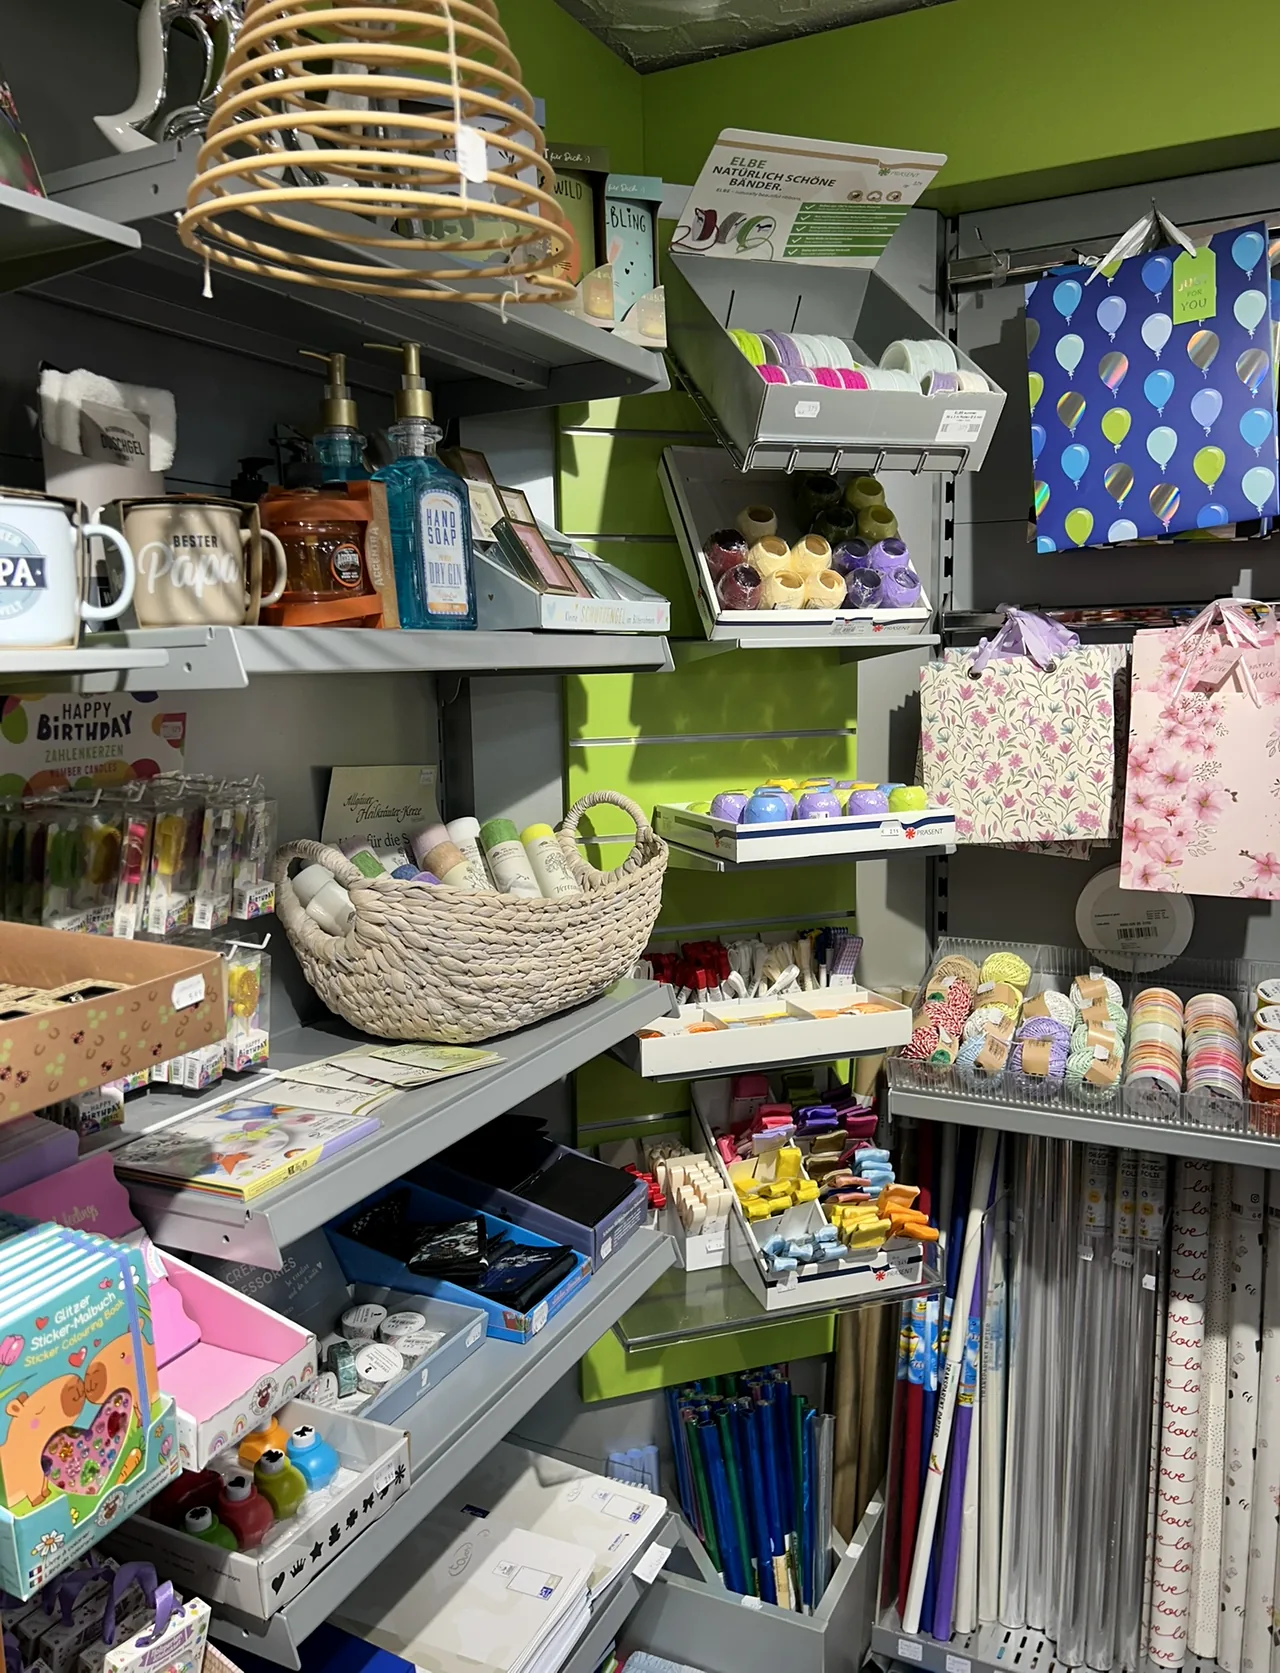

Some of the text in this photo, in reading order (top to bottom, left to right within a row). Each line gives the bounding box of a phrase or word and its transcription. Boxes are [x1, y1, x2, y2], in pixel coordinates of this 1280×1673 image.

[730, 156, 767, 169] ELBE
[712, 166, 837, 187] NATÜRLICH SCHÖNE
[729, 178, 782, 191] BÄNDER.
[553, 180, 583, 200] WILD
[1187, 289, 1203, 297] FOR
[1181, 298, 1207, 311] YOU
[101, 433, 146, 456] DUSCHGEL
[427, 508, 455, 528] HAND
[173, 535, 218, 548] BESTER
[428, 527, 456, 546] SOAP
[370, 527, 385, 587] ACCENTRA
[0, 558, 37, 587] PA
[138, 541, 239, 598] Papa
[429, 562, 462, 585] DRY GIN
[62, 702, 112, 721] HAPPY
[45, 744, 124, 763] ZAHLENKERZEN
[84, 763, 117, 776] CANDLES
[367, 833, 382, 849] für
[384, 832, 401, 848] die
[226, 1264, 257, 1285] CREA
[54, 1294, 91, 1325] Glitzer
[30, 1291, 117, 1351] Sticker-Malbuch
[24, 1299, 126, 1368] Sticker Colouring Book
[934, 1363, 952, 1438] TRANSPARENT PAPIER
